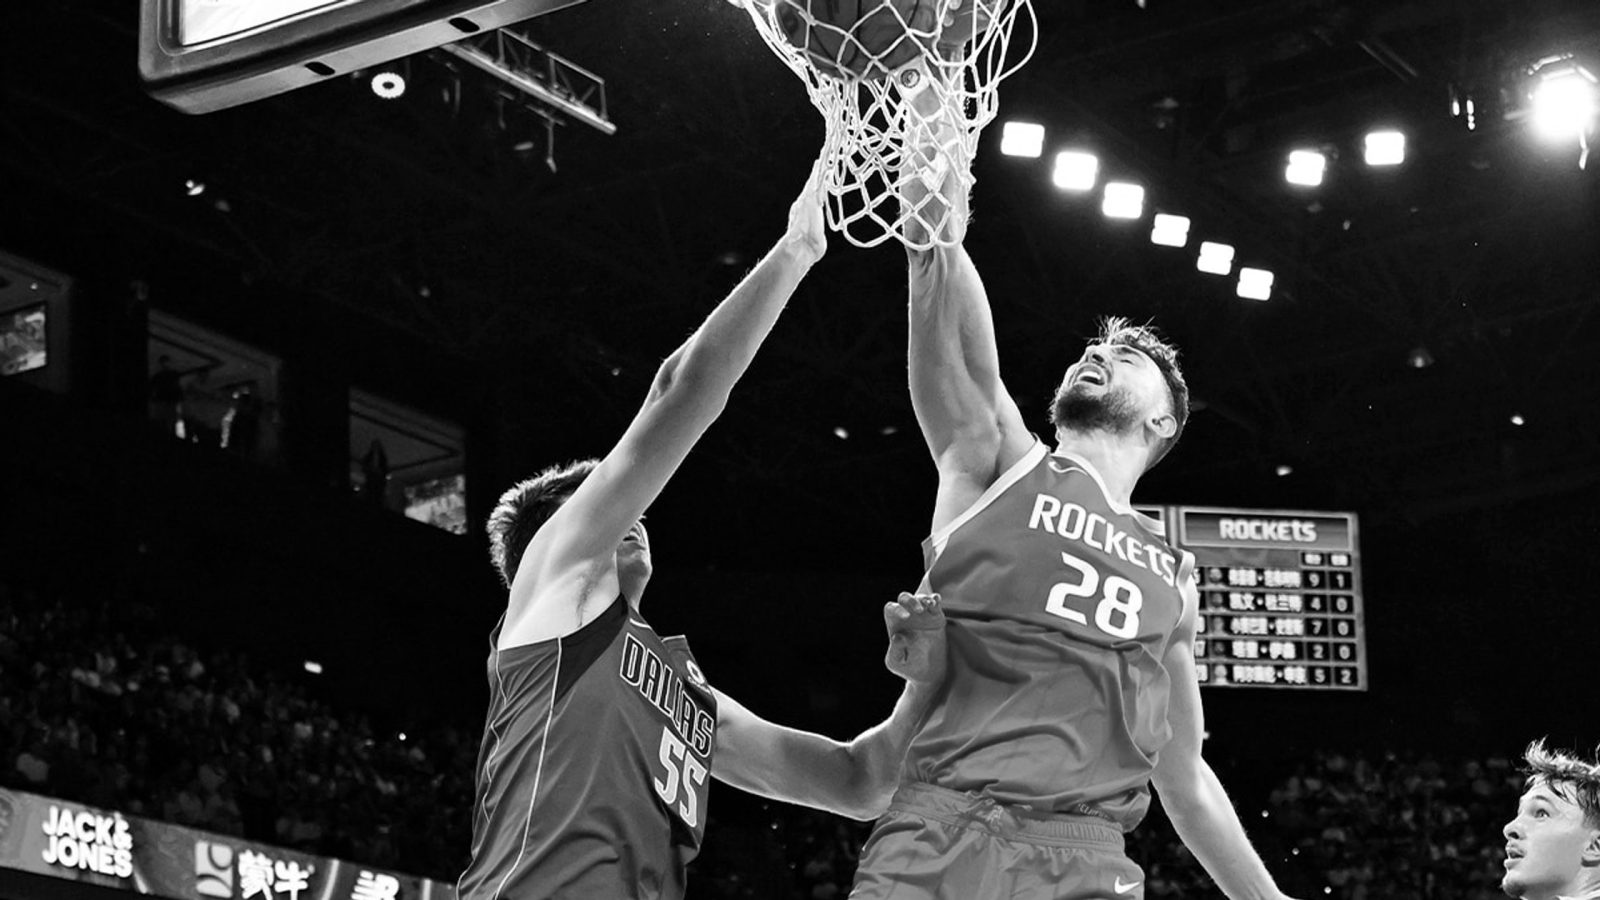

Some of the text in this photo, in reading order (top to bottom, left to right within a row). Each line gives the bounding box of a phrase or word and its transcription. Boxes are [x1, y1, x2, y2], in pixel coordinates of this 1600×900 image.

[1028, 493, 1176, 588] ROCKETS
[1219, 518, 1318, 542] ROCKETS
[1309, 572, 1320, 588] 9
[1336, 573, 1345, 589] 1
[1045, 551, 1143, 639] 28
[1310, 596, 1321, 611] 4
[1336, 596, 1348, 612] 0
[1311, 620, 1323, 635] 7
[1337, 620, 1349, 636] 0
[1312, 643, 1324, 659] 2
[1339, 644, 1350, 660] 0
[1314, 667, 1326, 683] 5
[1340, 668, 1352, 684] 2
[619, 632, 714, 758] DALLAS
[654, 726, 707, 827] 55
[42, 835, 133, 878] JONES
